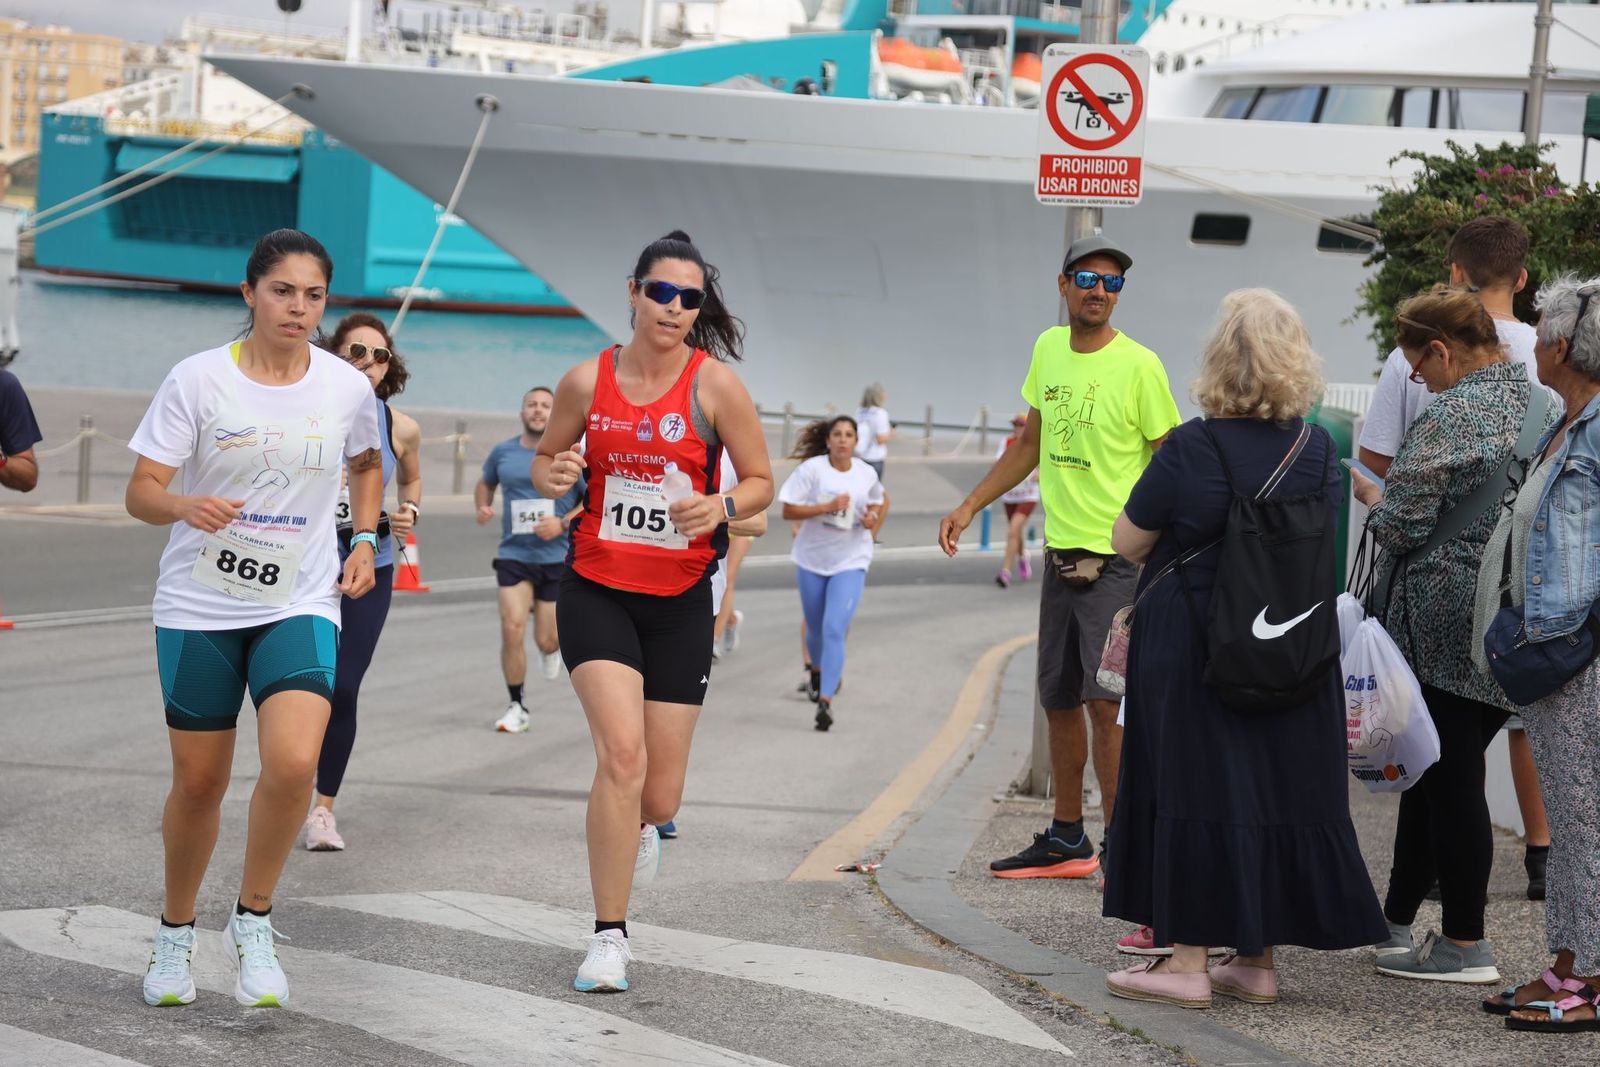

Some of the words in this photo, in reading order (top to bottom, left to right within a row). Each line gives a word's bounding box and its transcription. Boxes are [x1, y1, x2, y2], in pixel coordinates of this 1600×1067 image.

[1052, 157, 1128, 175] PROHIBIDO
[1040, 176, 1077, 192] USAR
[1081, 178, 1138, 195] DRONES
[608, 453, 667, 465] ATLETISMO
[291, 516, 307, 525] VIDA
[611, 502, 678, 534] 105
[239, 533, 274, 548] CARRERA
[216, 549, 280, 586] 868
